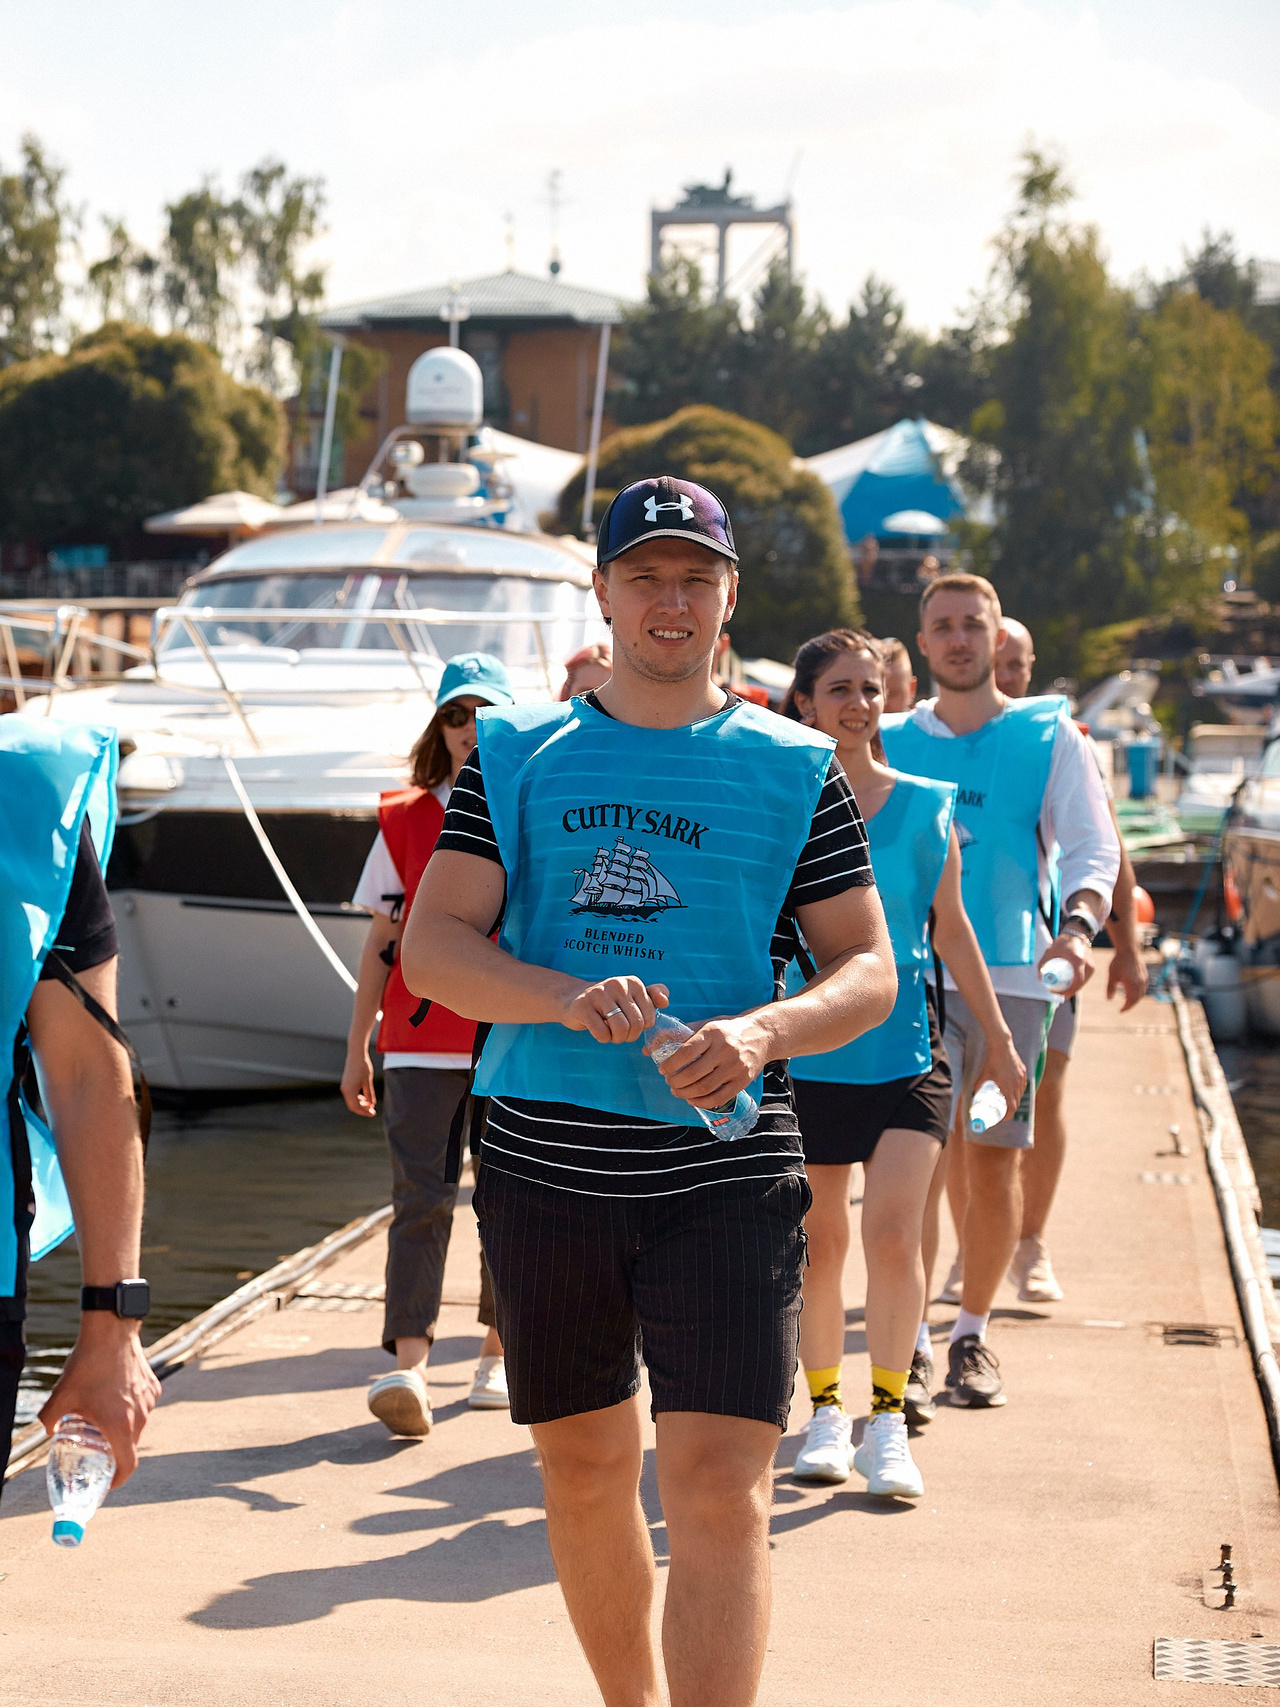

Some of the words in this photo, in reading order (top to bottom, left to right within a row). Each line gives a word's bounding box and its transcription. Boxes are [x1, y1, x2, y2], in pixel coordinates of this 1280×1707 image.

[956, 789, 987, 809] ARK
[562, 803, 643, 833] CUTTY
[641, 809, 710, 850] SARK
[584, 927, 645, 945] BLENDED
[563, 938, 610, 955] SCOTCH
[613, 944, 665, 961] WHISKY
